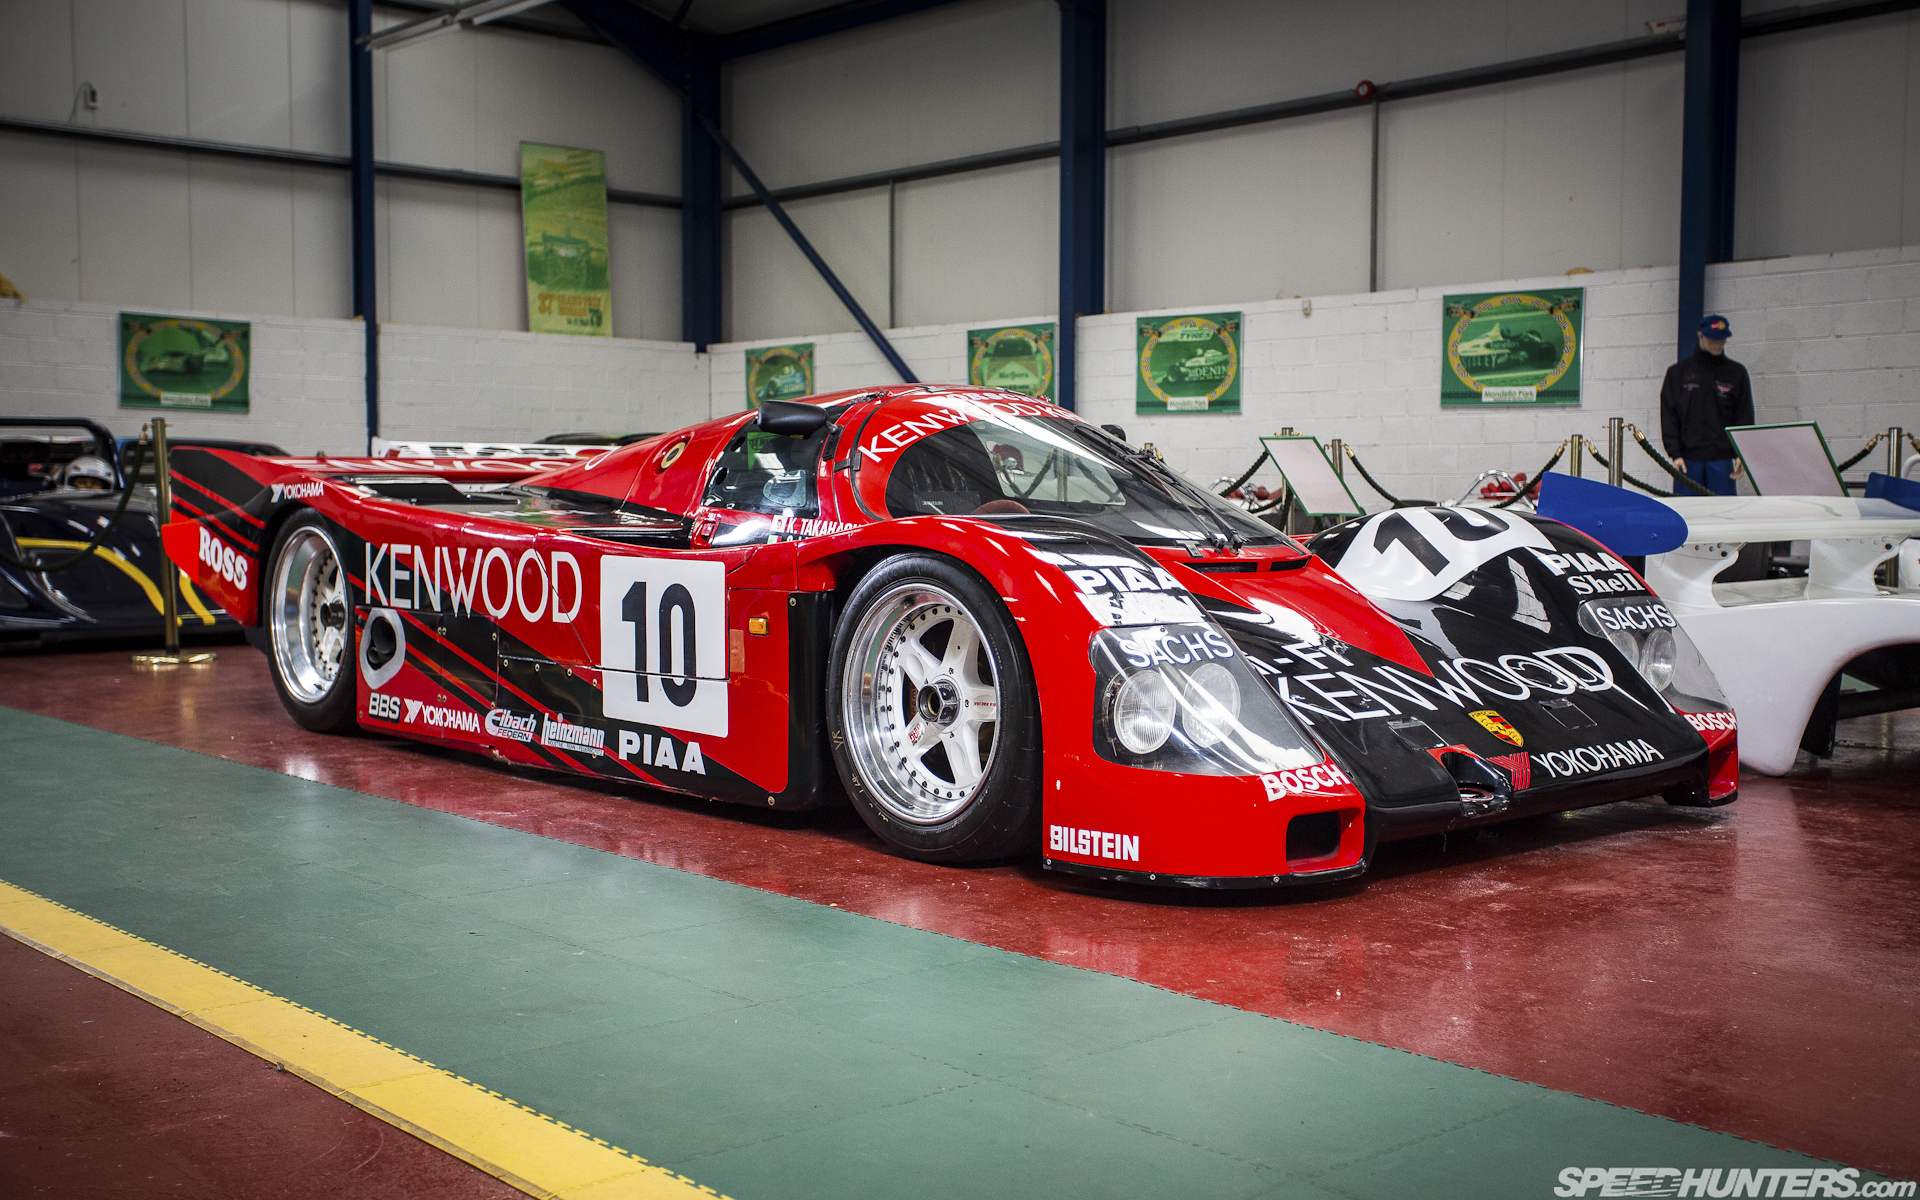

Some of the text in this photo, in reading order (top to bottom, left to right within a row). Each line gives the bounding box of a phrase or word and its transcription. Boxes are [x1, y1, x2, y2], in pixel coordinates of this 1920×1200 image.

[858, 401, 1042, 464] KENWOOD
[282, 481, 325, 500] YOKOHAMA
[198, 525, 249, 591] ROSS
[1373, 506, 1511, 577] 10
[1064, 565, 1187, 595] PIAA
[1538, 551, 1631, 576] PIAA
[364, 542, 583, 624] KENWOOD
[1566, 573, 1646, 596] Shell
[1596, 603, 1678, 631] SACHS
[621, 580, 698, 708] 10
[1118, 629, 1235, 669] SACHS
[1277, 646, 1615, 726] KENWOOD
[368, 691, 401, 722] BBS
[421, 704, 481, 734] YOKOHAMA
[485, 708, 537, 736] Eibach
[1683, 712, 1738, 732] BOSCH
[497, 728, 531, 741] FEDERN
[541, 712, 605, 749] heinzmann
[618, 729, 706, 776] PIAA
[1531, 738, 1665, 779] YOKOHAMA
[1261, 763, 1350, 803] BOSCH
[1050, 824, 1140, 862] BILSTEIN
